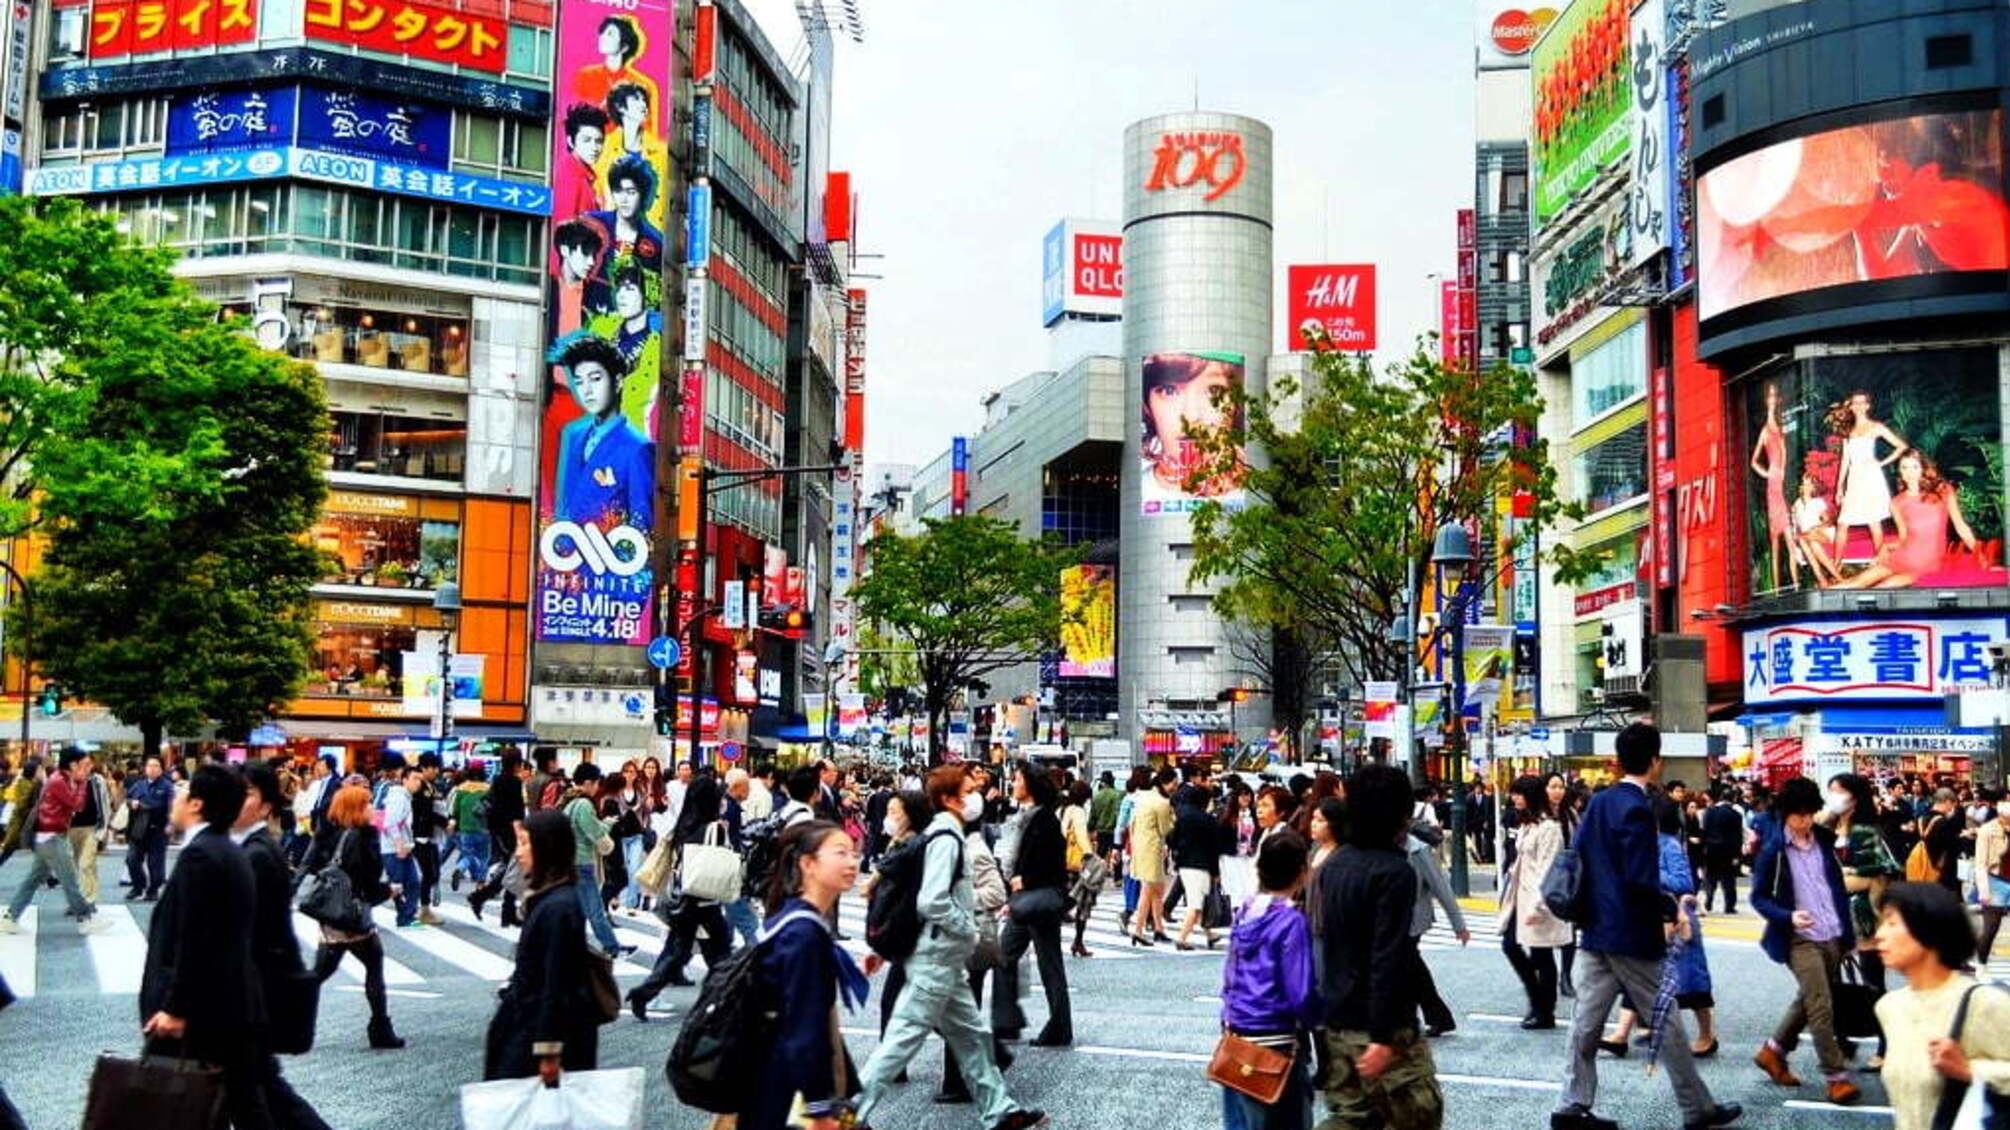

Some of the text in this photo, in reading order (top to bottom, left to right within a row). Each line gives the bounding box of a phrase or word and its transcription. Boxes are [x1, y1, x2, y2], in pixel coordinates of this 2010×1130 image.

[32, 172, 87, 192] AEON
[300, 156, 368, 182] AEON
[1144, 146, 1246, 201] 109
[381, 165, 547, 209] 英会話イーオン
[1307, 273, 1359, 308] H&M
[544, 573, 646, 594] INFINITE
[543, 590, 641, 620] Be Mine
[592, 618, 640, 639] 4.18!
[1750, 632, 1991, 688] 大盛堂書店
